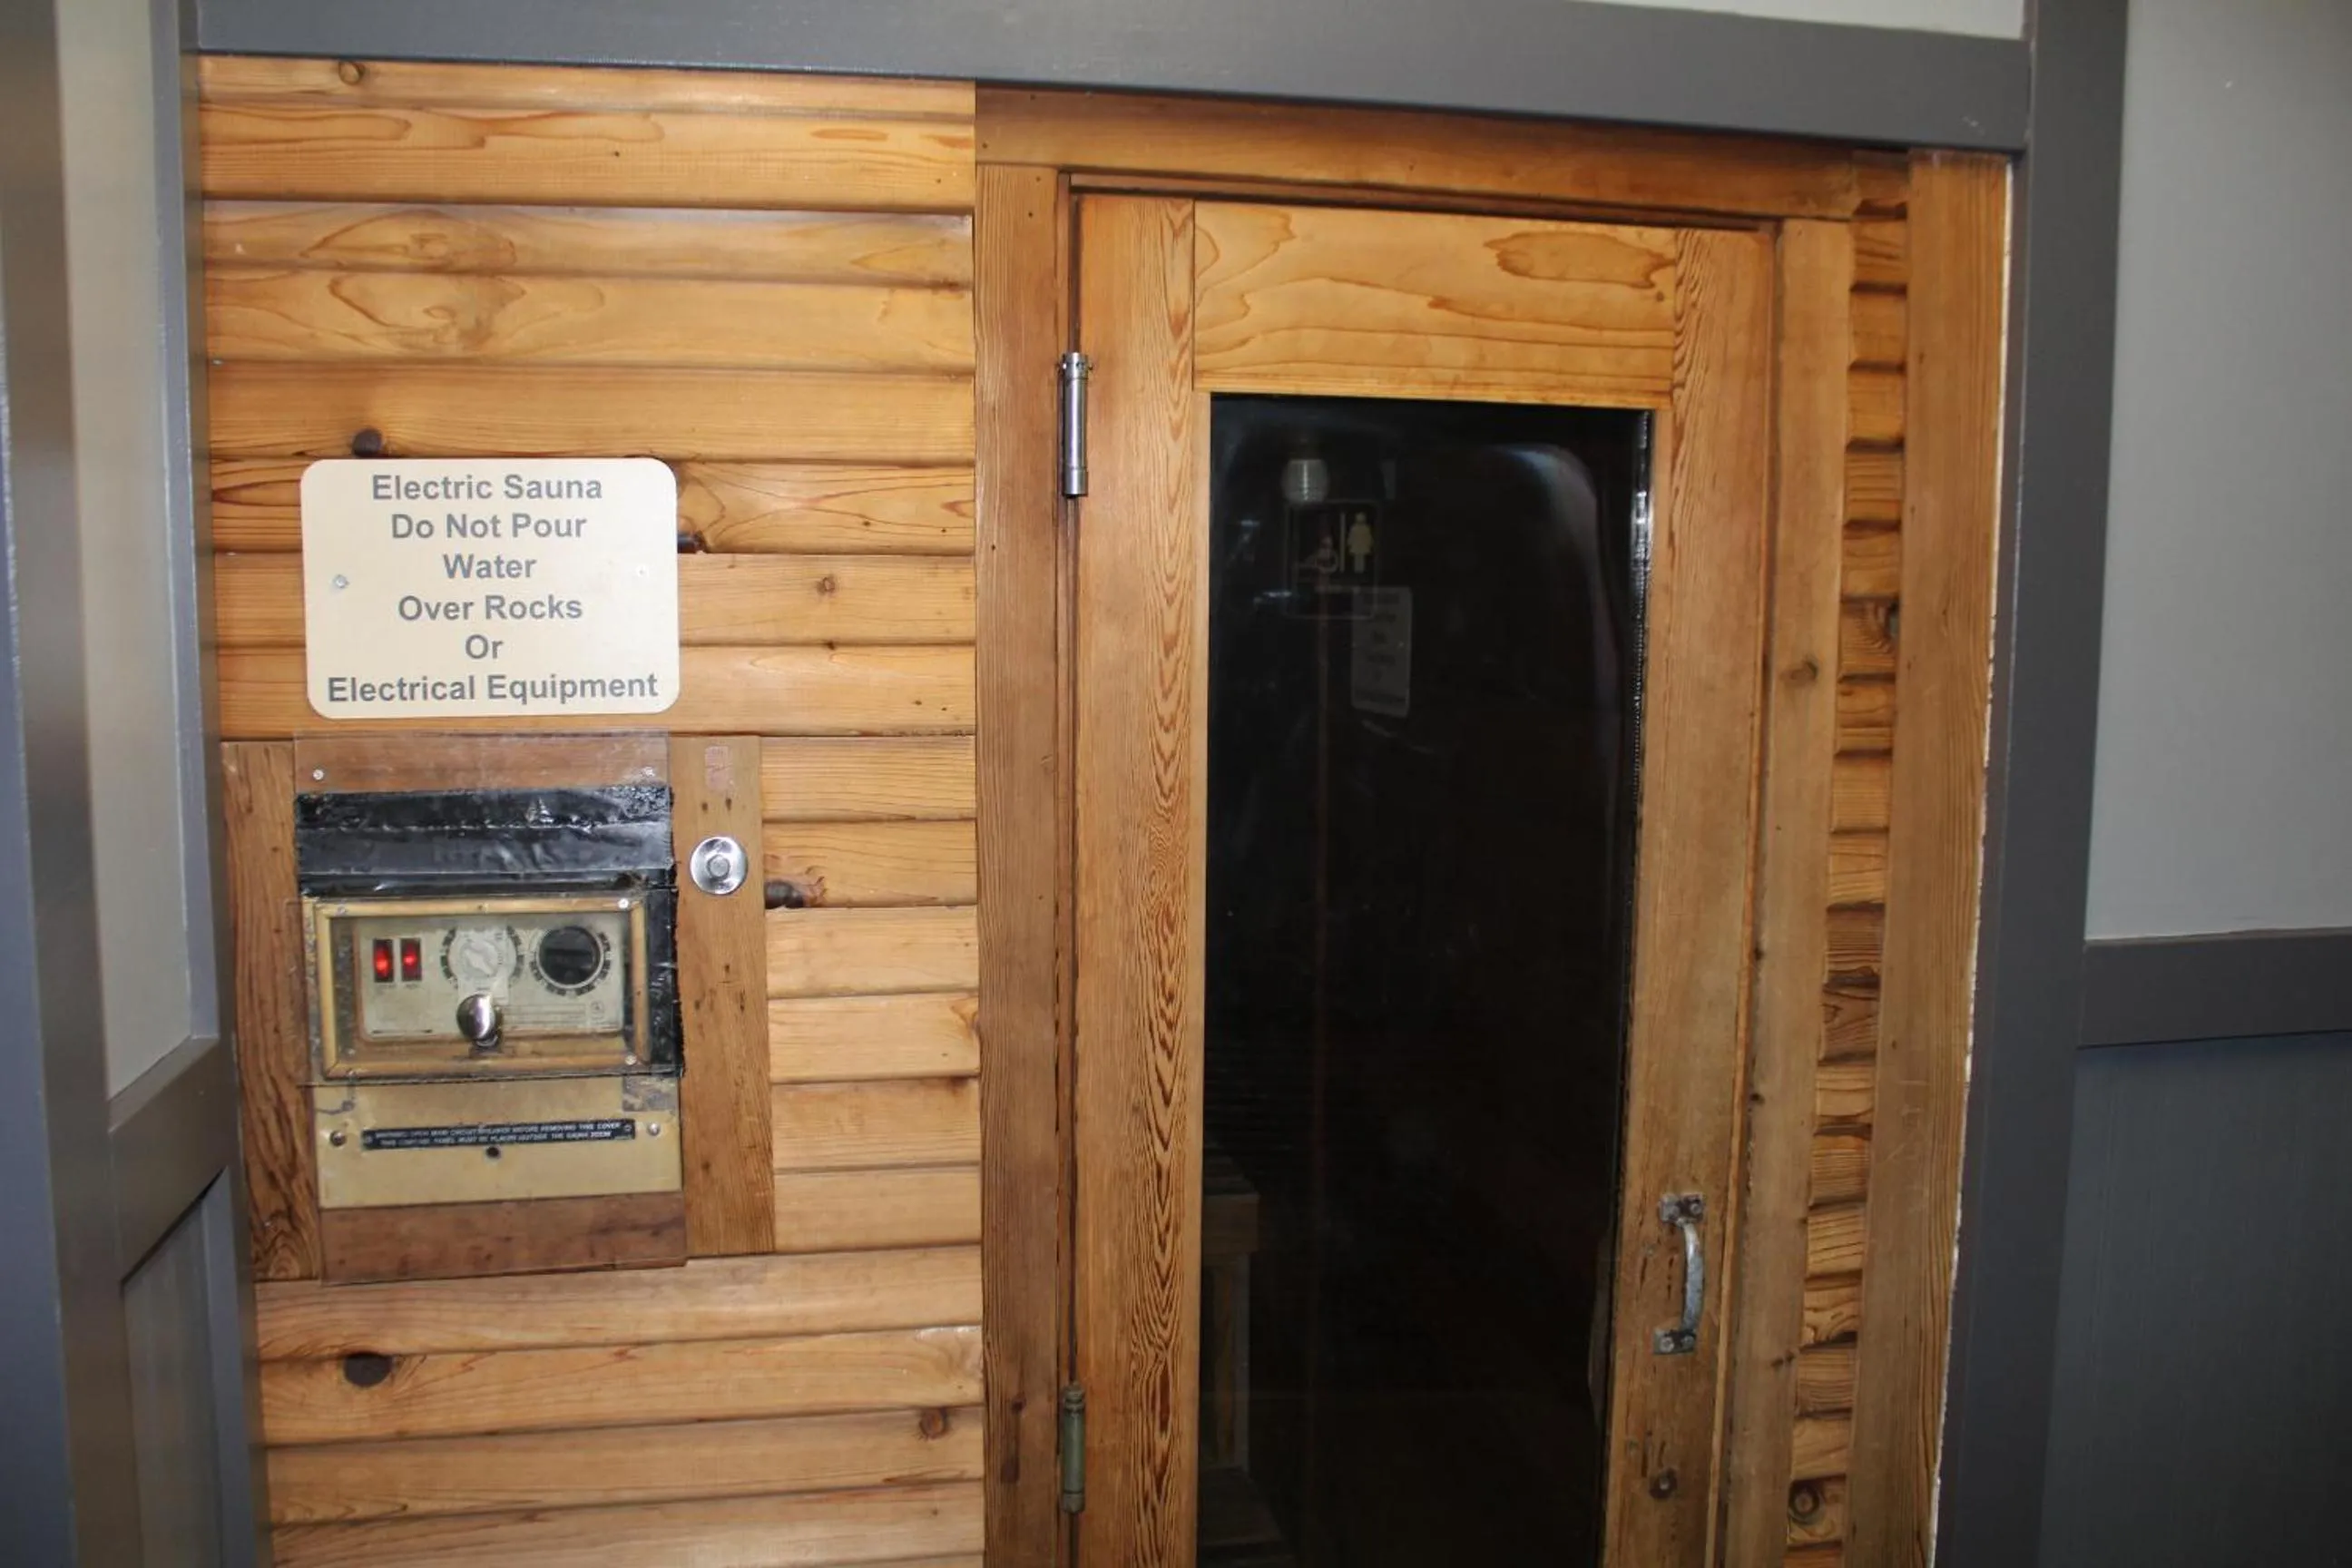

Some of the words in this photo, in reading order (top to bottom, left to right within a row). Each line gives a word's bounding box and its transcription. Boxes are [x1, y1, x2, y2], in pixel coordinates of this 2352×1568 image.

[372, 474, 493, 500] Electric
[504, 474, 603, 500] Sauna
[391, 514, 435, 539] Do
[446, 514, 501, 539] Not
[512, 513, 586, 538] Pour
[443, 554, 537, 579] Water
[397, 595, 474, 621] Over
[485, 594, 583, 620] Rocks
[465, 634, 504, 660] Or
[328, 675, 475, 701] Electrical
[487, 672, 659, 704] Equipment
